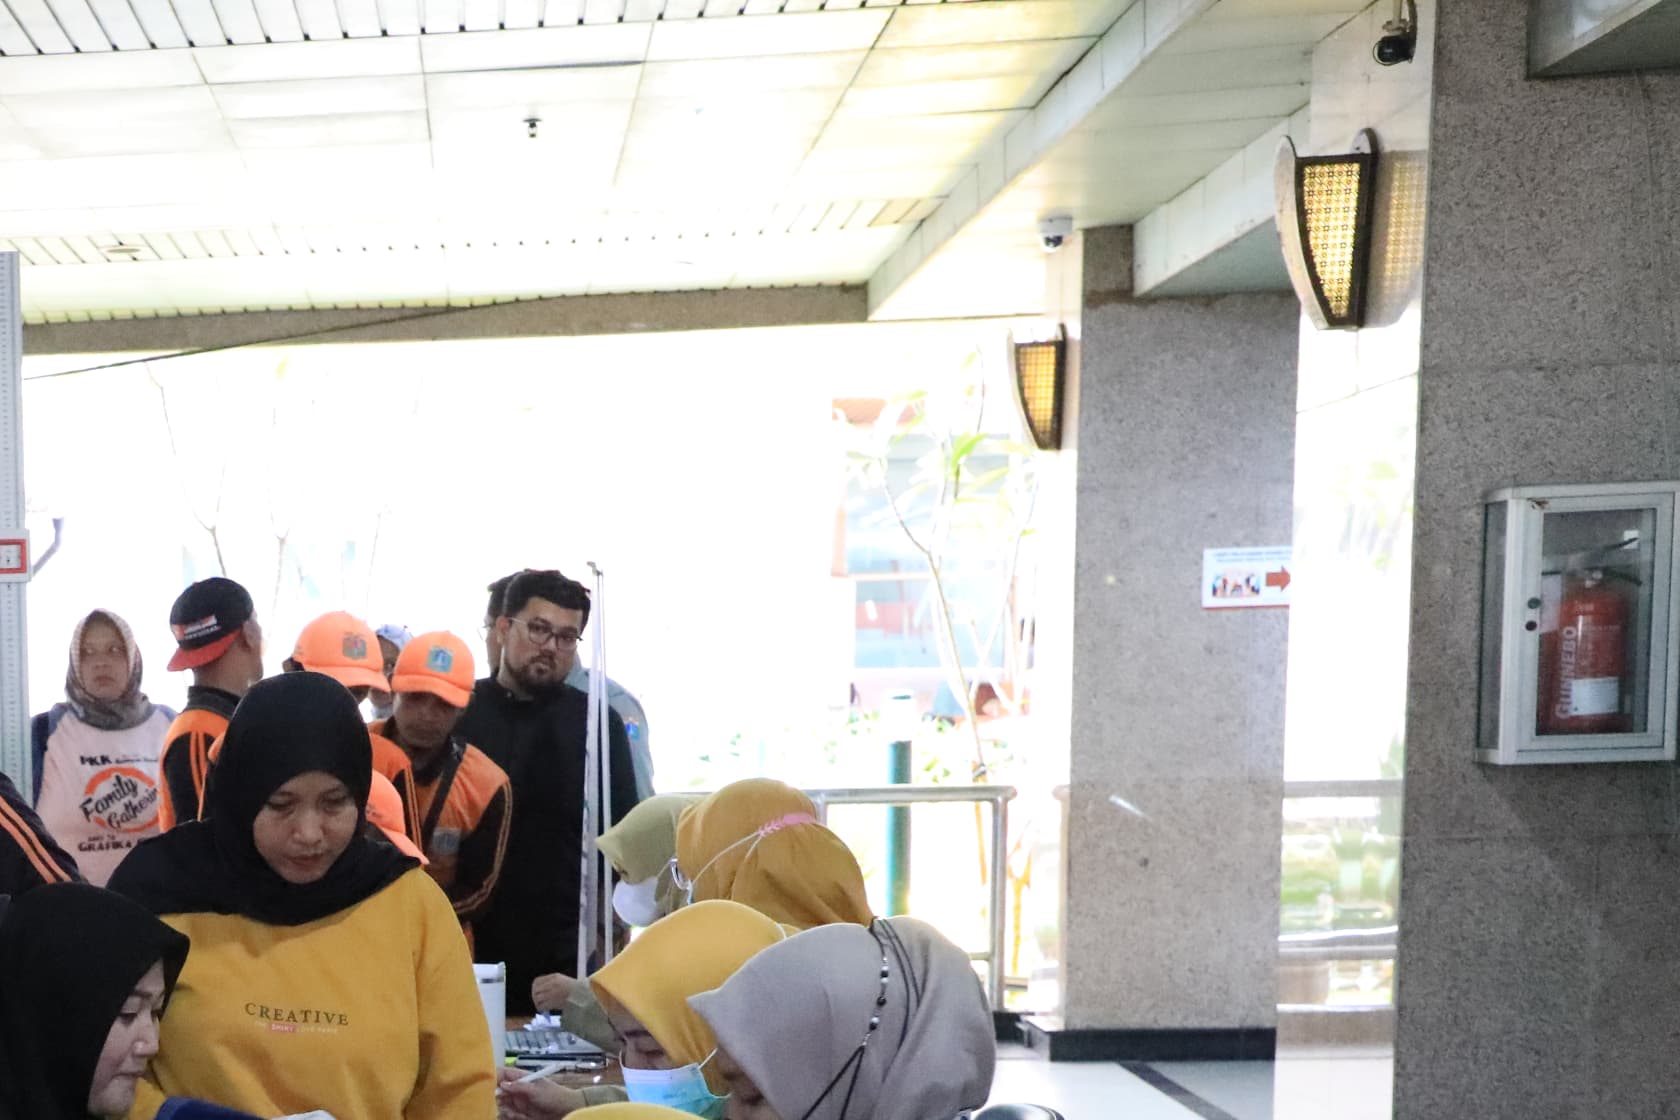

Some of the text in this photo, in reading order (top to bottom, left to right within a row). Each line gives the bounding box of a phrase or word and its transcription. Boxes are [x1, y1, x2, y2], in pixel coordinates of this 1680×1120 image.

[1554, 626, 1578, 718] GUNNEBO
[79, 774, 138, 823] Family
[244, 1002, 349, 1026] CREATIVE
